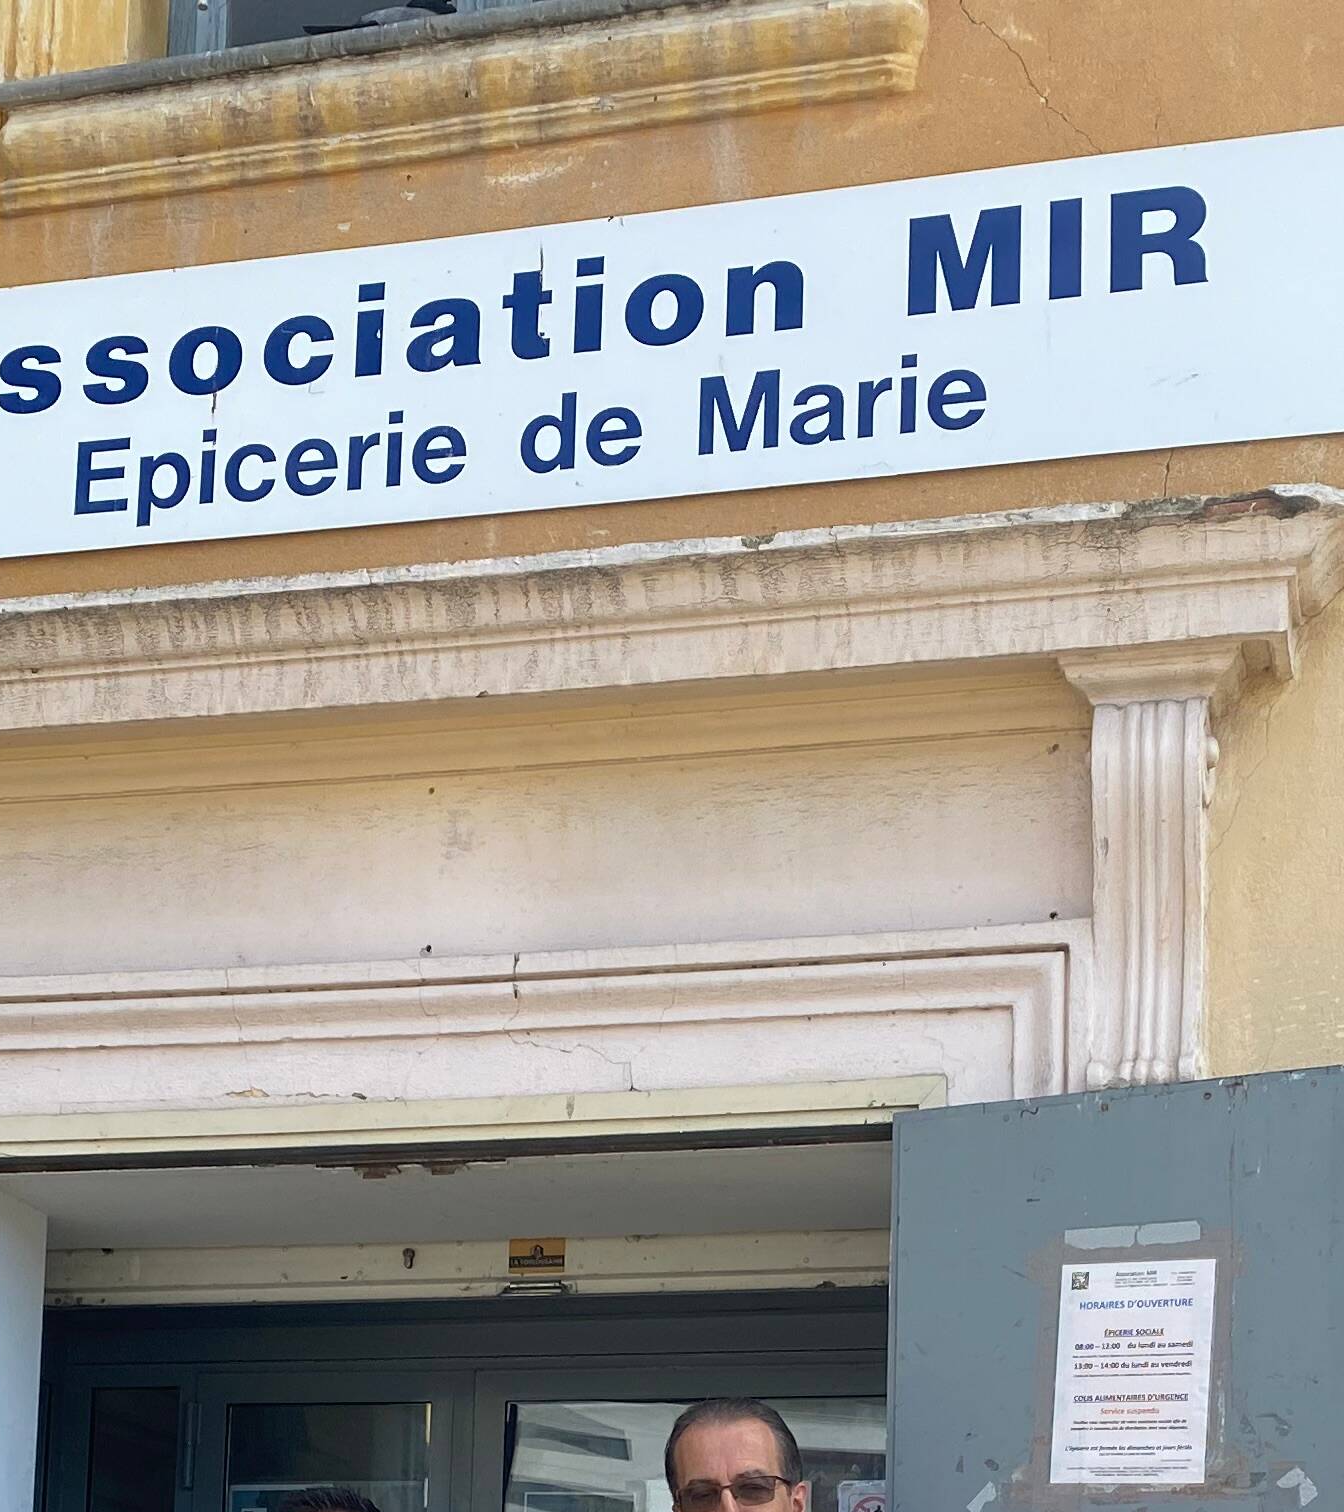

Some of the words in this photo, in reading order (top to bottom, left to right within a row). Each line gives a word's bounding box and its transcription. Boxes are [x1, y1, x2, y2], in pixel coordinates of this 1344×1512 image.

[907, 185, 1208, 317] MIR
[74, 411, 467, 527] Epicerie
[520, 392, 642, 473] de
[697, 353, 987, 455] Marie
[1079, 1301, 1125, 1310] HORAIRES
[1127, 1298, 1193, 1309] D'OUVERTURE
[1161, 1360, 1192, 1368] vendredi
